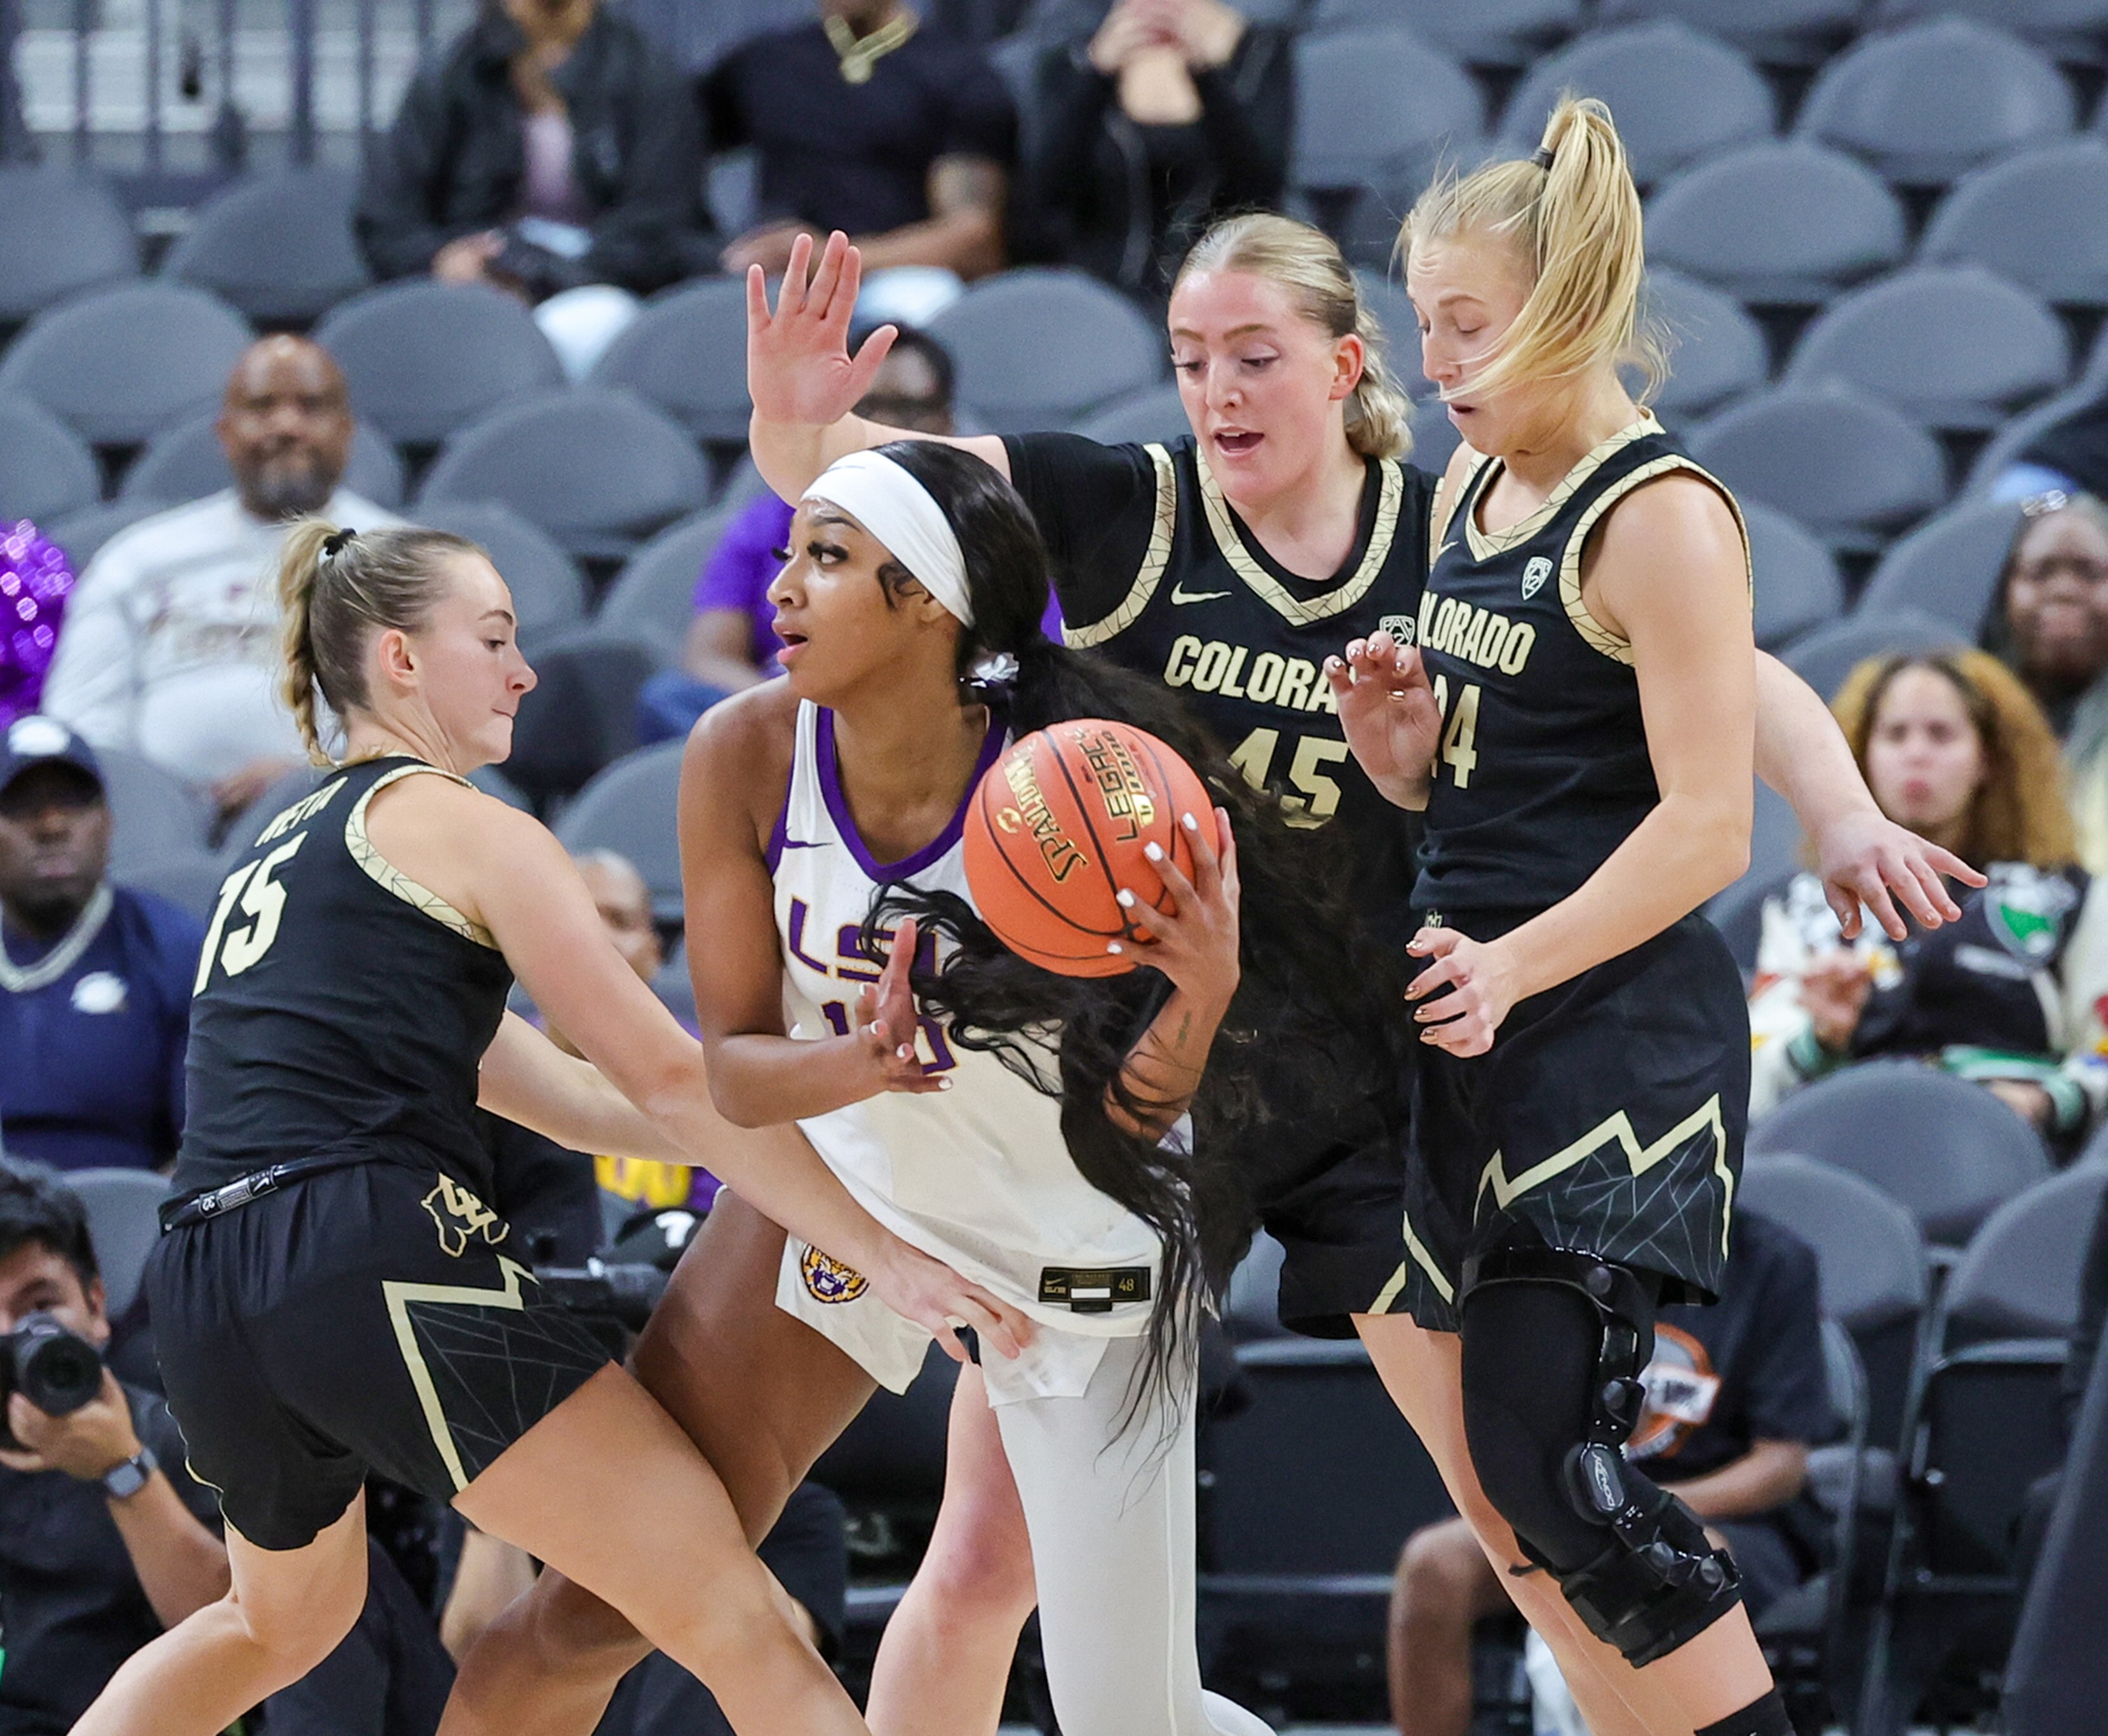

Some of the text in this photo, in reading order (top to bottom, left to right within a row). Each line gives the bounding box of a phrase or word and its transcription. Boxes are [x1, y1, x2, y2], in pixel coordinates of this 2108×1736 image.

[1164, 634, 1357, 714] COLORA
[1417, 590, 1536, 676] OLORADO
[1003, 738, 1088, 883] SPALDING
[1064, 727, 1138, 843] LEGACY
[1208, 727, 1349, 831] 45
[193, 830, 309, 999] 15
[1119, 1277, 1135, 1292] 48
